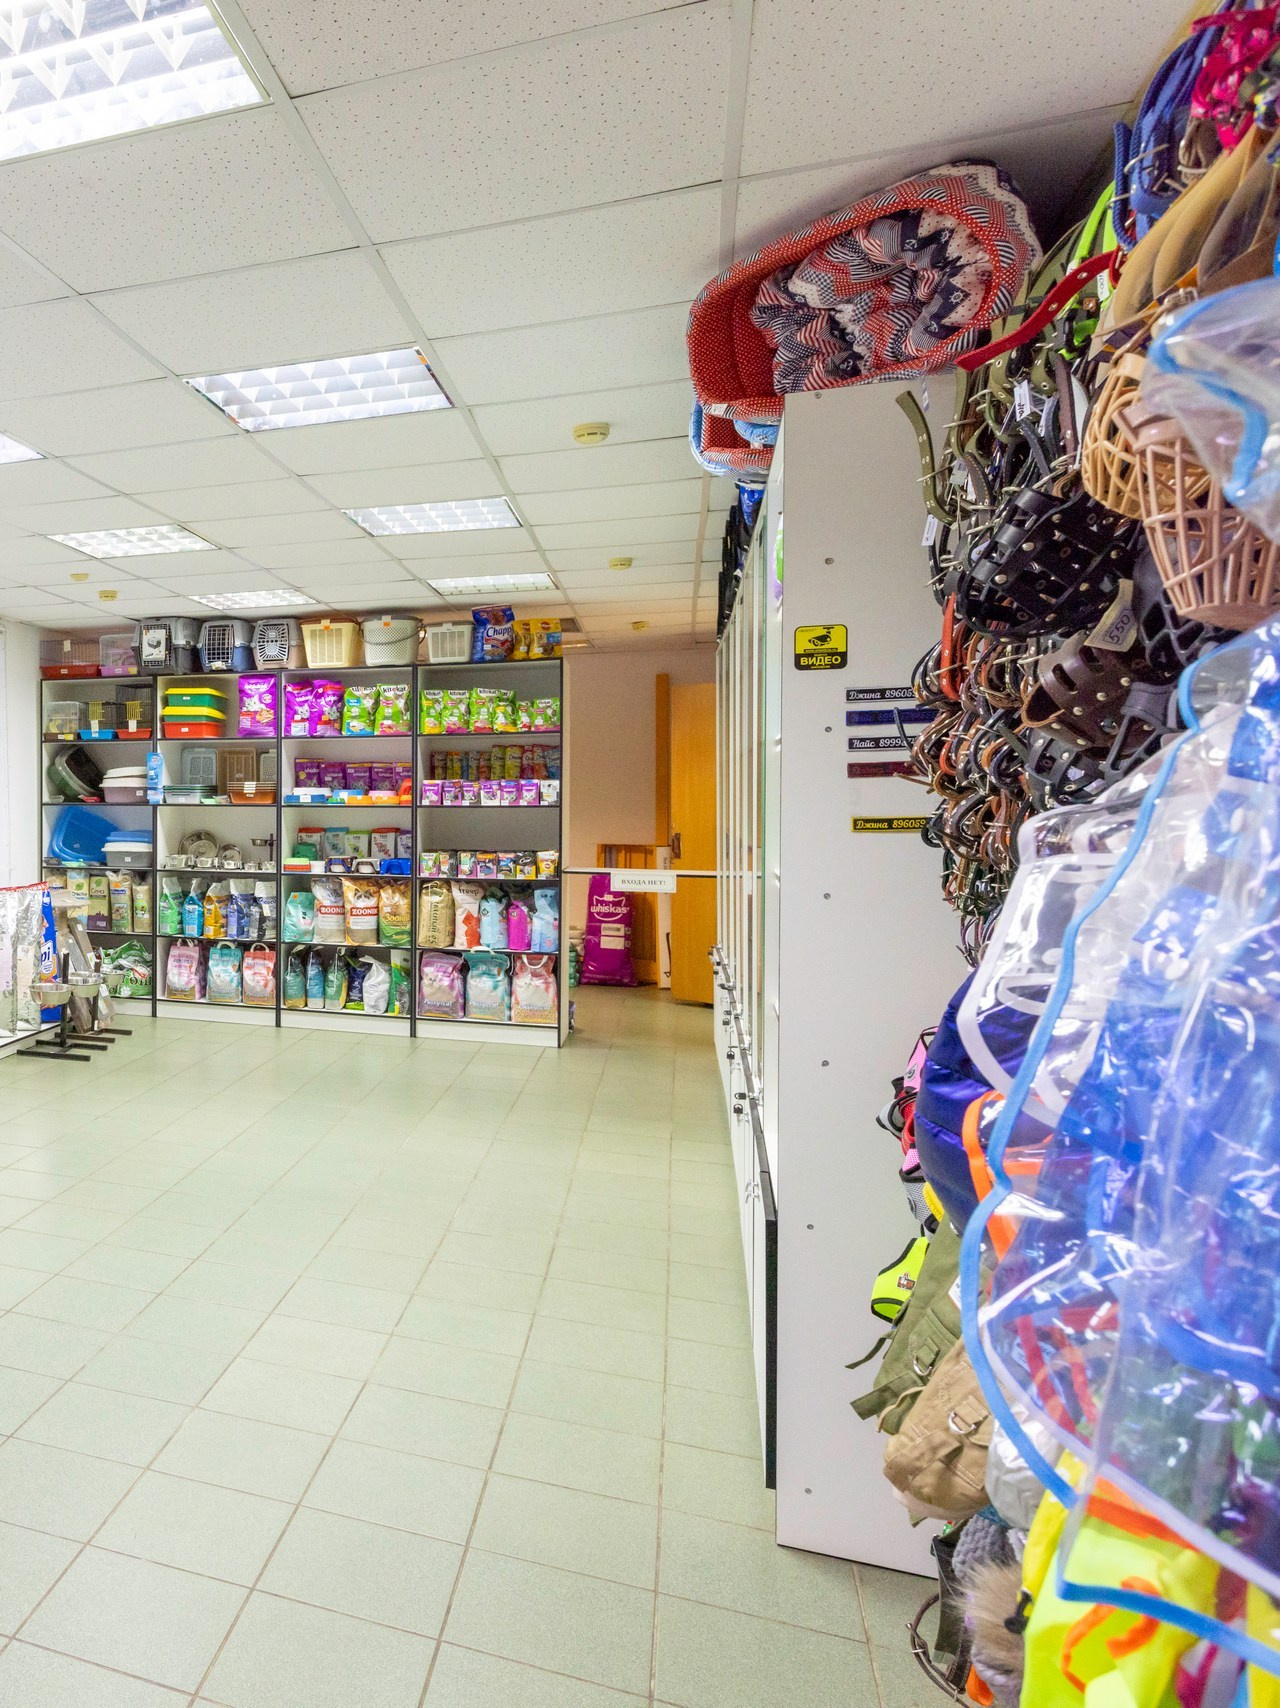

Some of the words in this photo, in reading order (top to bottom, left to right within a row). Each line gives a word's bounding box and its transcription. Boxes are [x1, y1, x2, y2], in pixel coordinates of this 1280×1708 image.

[1108, 614, 1131, 645] 550
[800, 655, 842, 666] ВИДЕО
[848, 690, 882, 700] Джина
[852, 737, 876, 748] Найс
[855, 820, 889, 829] Джина
[590, 904, 629, 914] whiskas
